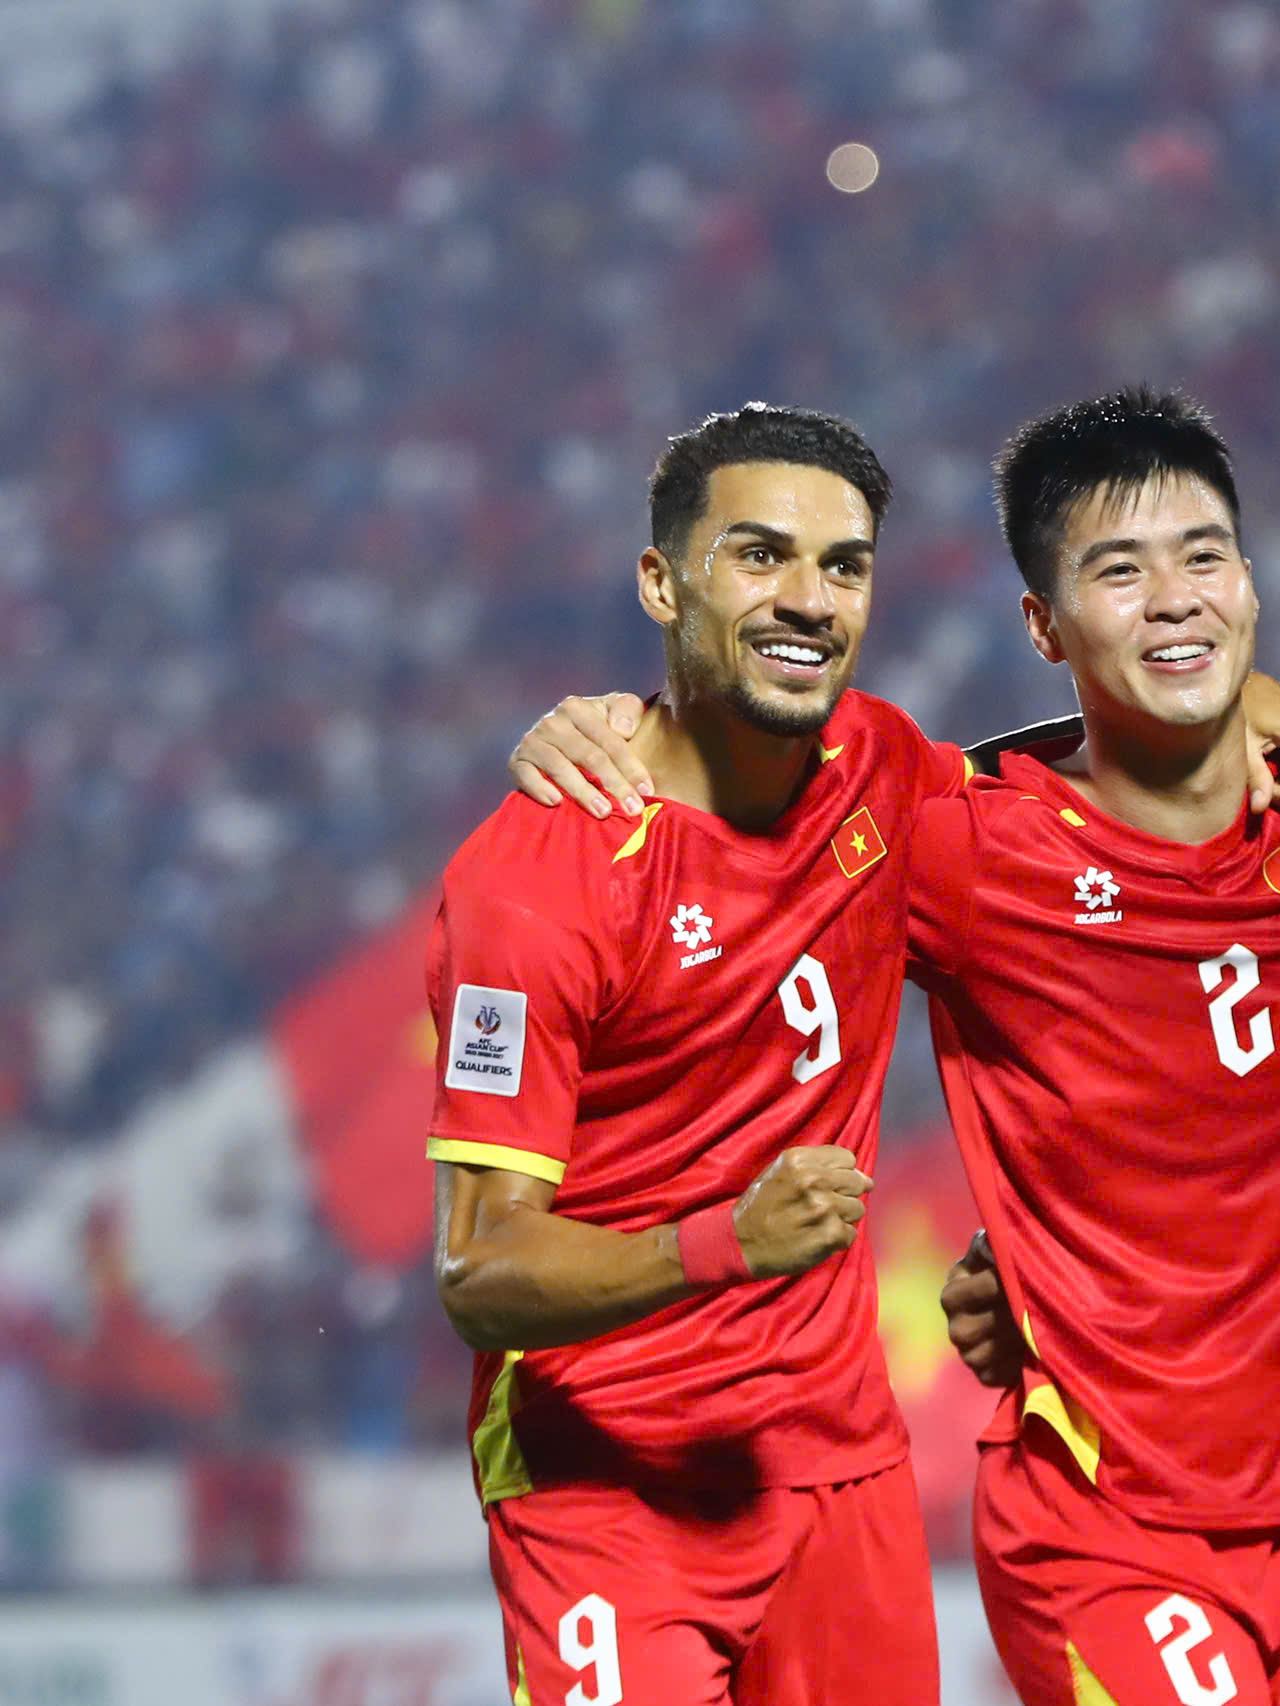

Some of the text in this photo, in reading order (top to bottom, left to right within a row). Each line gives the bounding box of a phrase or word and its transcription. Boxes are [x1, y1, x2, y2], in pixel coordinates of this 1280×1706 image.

[1074, 910, 1122, 924] JOGARBOLA
[777, 952, 842, 1085] 9
[1198, 942, 1276, 1078] 2
[455, 1060, 512, 1076] QUALIFIERS
[558, 1592, 624, 1706] 9
[1144, 1593, 1238, 1706] 2
